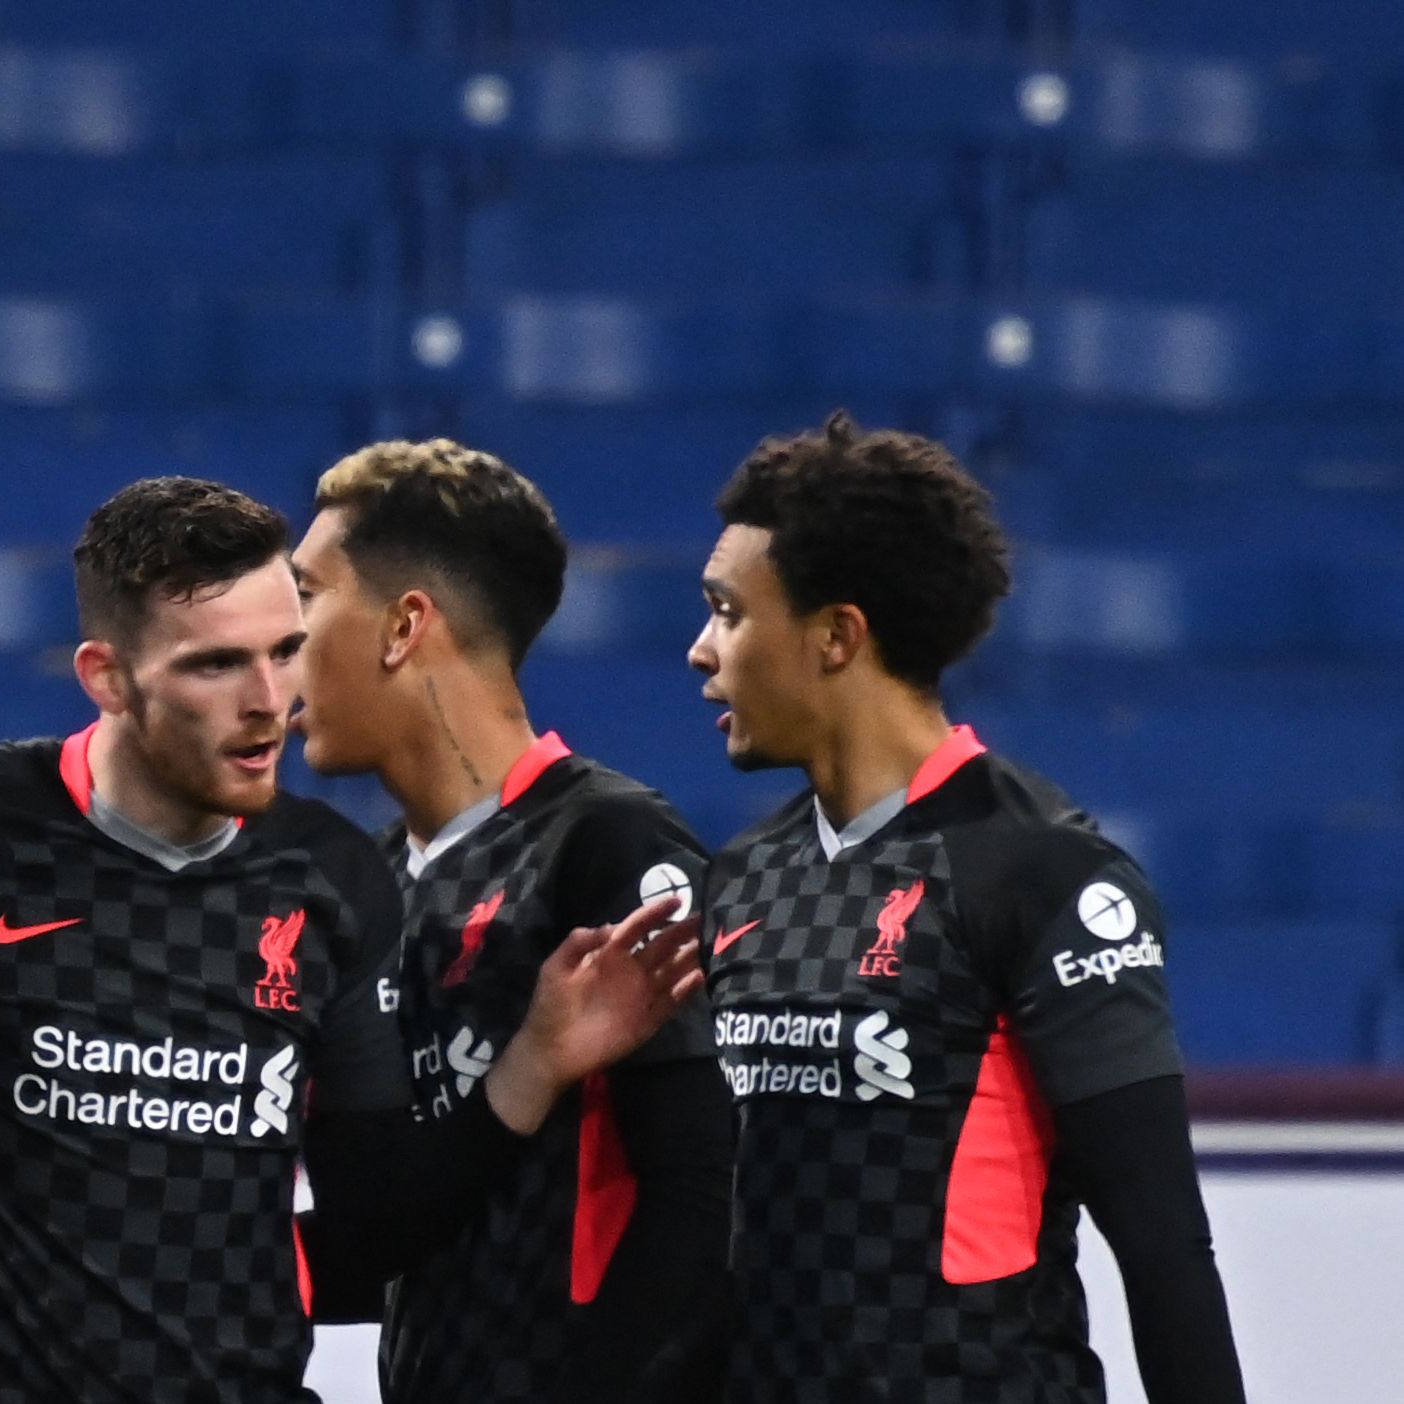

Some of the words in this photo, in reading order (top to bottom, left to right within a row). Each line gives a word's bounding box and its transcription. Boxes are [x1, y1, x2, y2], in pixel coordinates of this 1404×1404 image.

[857, 956, 901, 977] LFC
[254, 986, 302, 1012] LFC
[714, 1006, 842, 1049] Standard
[31, 1025, 248, 1085] Standard
[718, 1056, 842, 1099] hartered
[13, 1073, 242, 1136] Chartered
